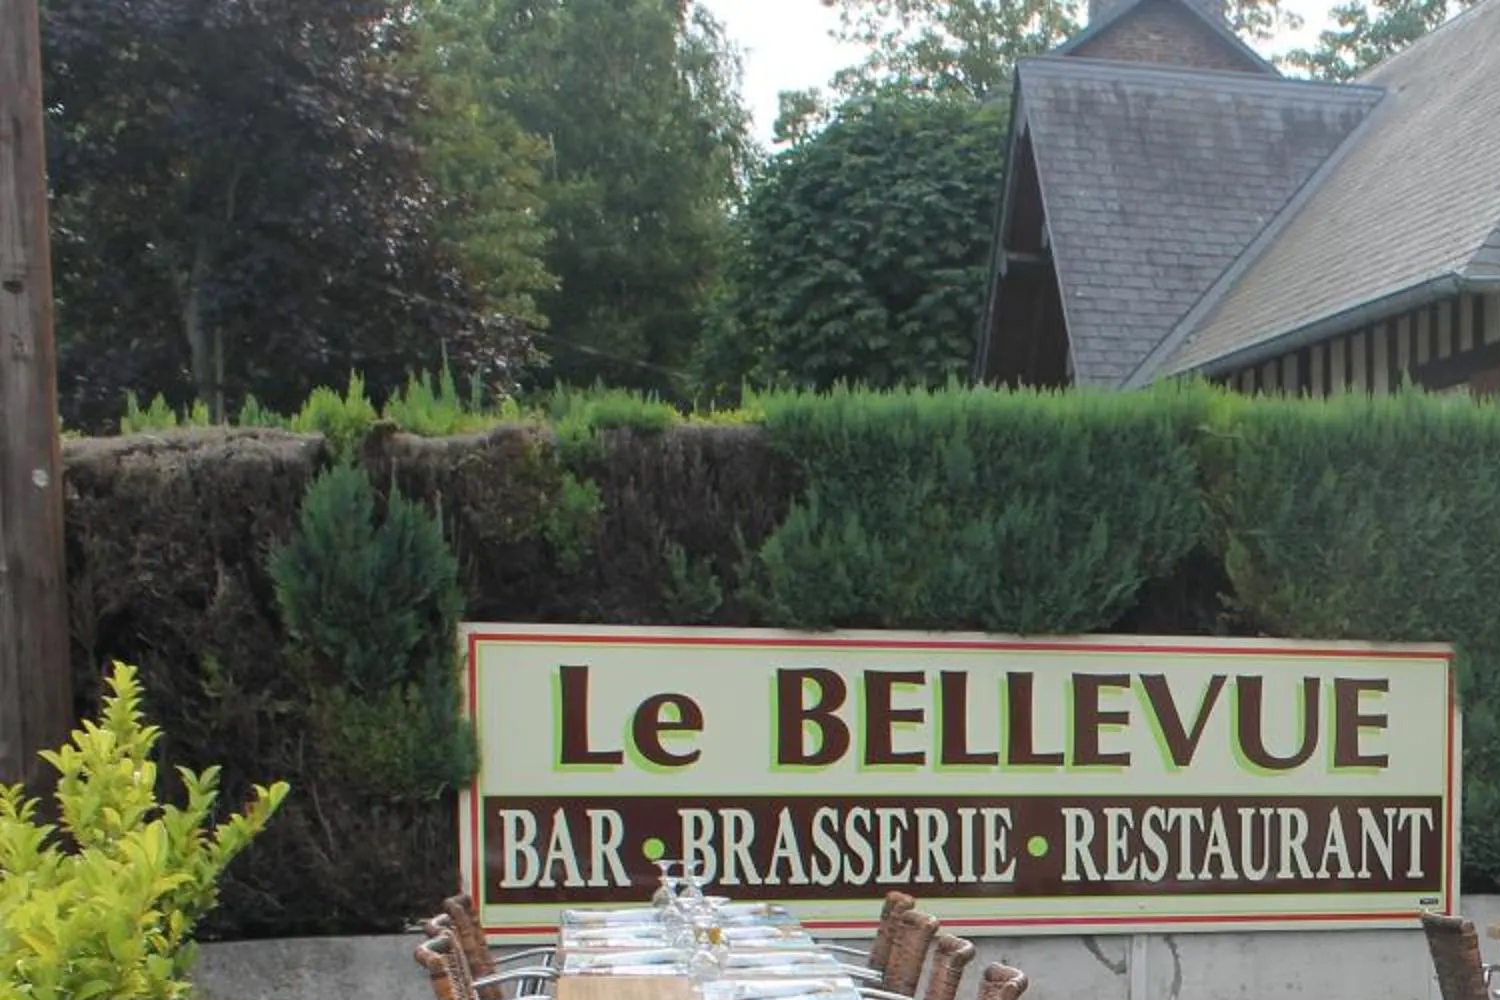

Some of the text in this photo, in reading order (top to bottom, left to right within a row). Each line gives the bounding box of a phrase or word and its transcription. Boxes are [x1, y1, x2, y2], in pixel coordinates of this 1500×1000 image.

[553, 665, 1390, 774] Le BELLEVUE
[499, 805, 1434, 889] BAR BRASSERIE RESTAURANT
